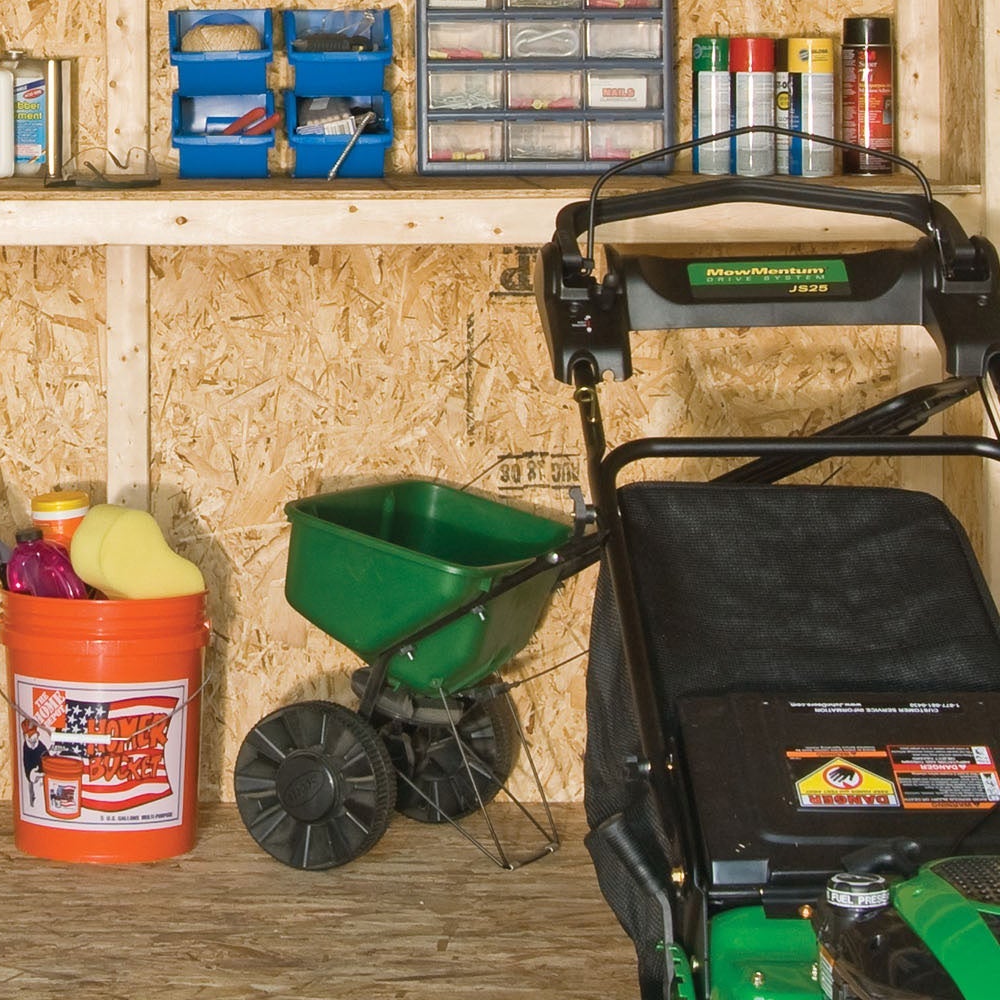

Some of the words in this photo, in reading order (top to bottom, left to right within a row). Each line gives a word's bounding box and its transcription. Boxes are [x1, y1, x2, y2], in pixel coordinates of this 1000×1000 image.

[602, 87, 635, 98] NAILS
[17, 101, 40, 110] bber
[17, 112, 42, 120] ment
[707, 267, 824, 276] MowMentum
[788, 284, 829, 293] JS25
[33, 690, 66, 726] HOME
[86, 712, 169, 755] HOMER
[89, 754, 163, 782] BUCKET
[808, 795, 890, 805] DANGER
[831, 892, 854, 905] FUEL
